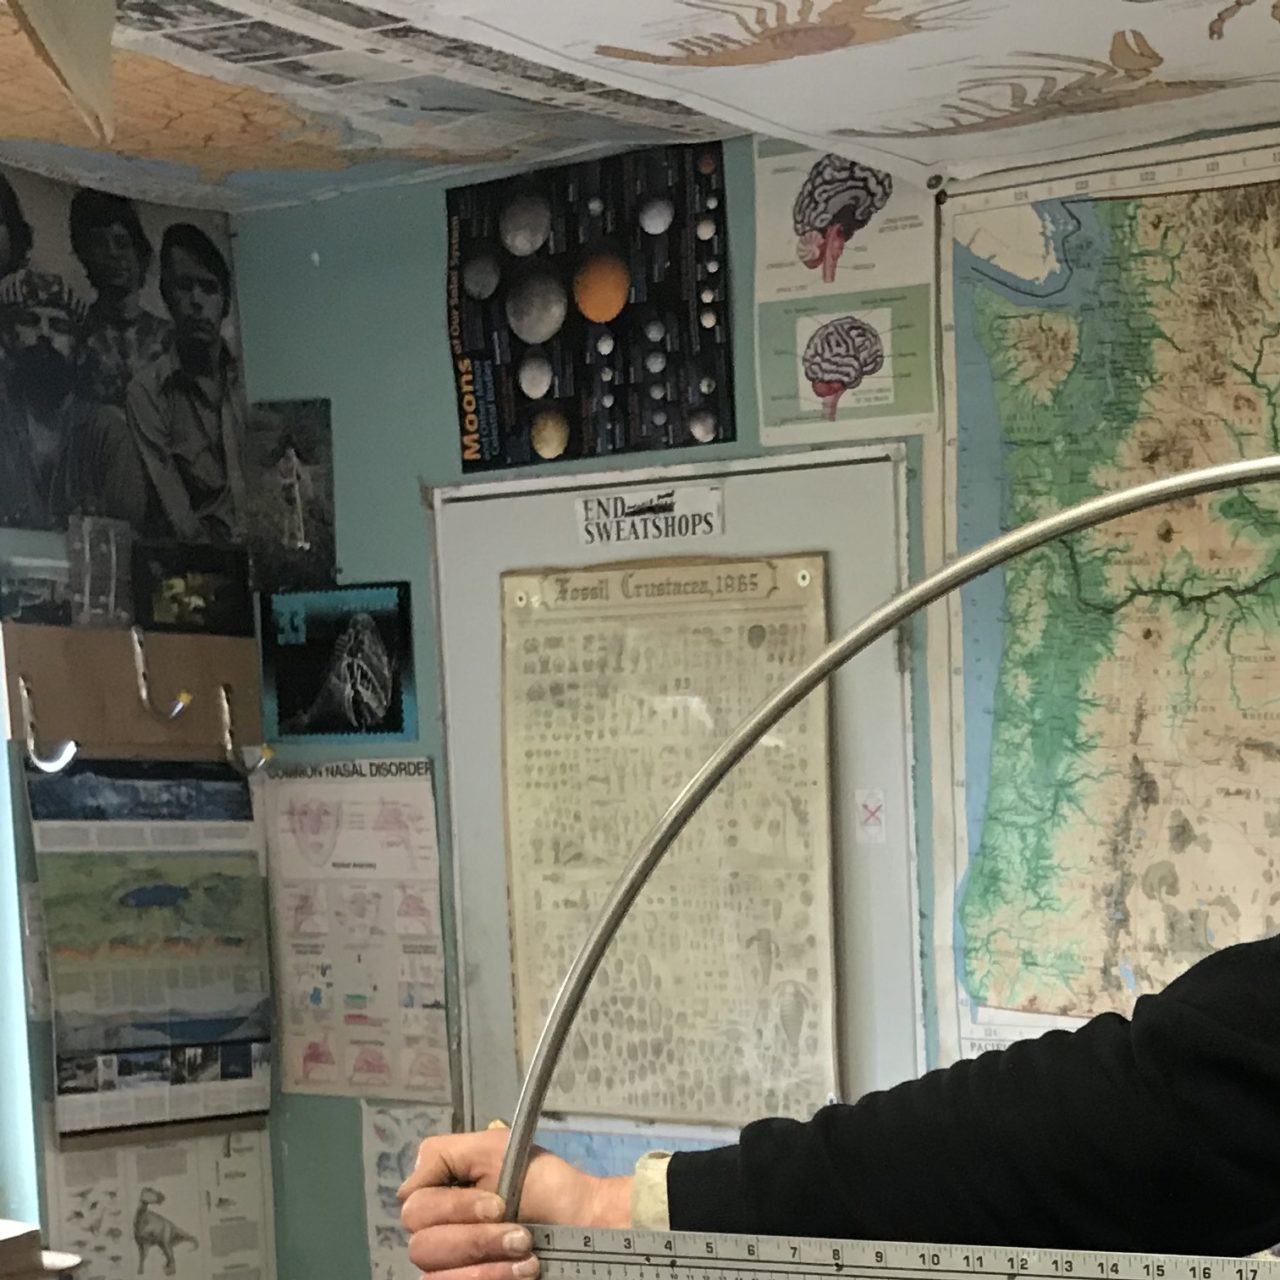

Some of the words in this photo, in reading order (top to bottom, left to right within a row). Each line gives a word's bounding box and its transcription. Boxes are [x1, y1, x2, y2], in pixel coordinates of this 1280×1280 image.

[450, 309, 461, 337] Our
[457, 358, 481, 460] Moons
[583, 496, 626, 522] END
[584, 512, 714, 545] SWEATSHOPS
[555, 573, 610, 603] Fossil
[325, 763, 366, 778] NASAL
[369, 761, 434, 778] DISORDER
[544, 1234, 551, 1245] 1
[583, 1236, 591, 1247] 2
[624, 1238, 631, 1249] 3
[664, 1240, 672, 1251] 4
[706, 1242, 713, 1254] 5
[748, 1244, 755, 1255] 6
[790, 1247, 798, 1259] 7
[832, 1249, 840, 1260] 8
[875, 1251, 883, 1263] 9
[919, 1254, 940, 1266] 10
[964, 1255, 983, 1268] 11
[1007, 1257, 1028, 1270] 12
[1052, 1259, 1073, 1272] 13
[1098, 1262, 1119, 1275] 14
[1144, 1265, 1165, 1277] 15
[1190, 1267, 1211, 1279] 16
[1237, 1269, 1258, 1280] 17
